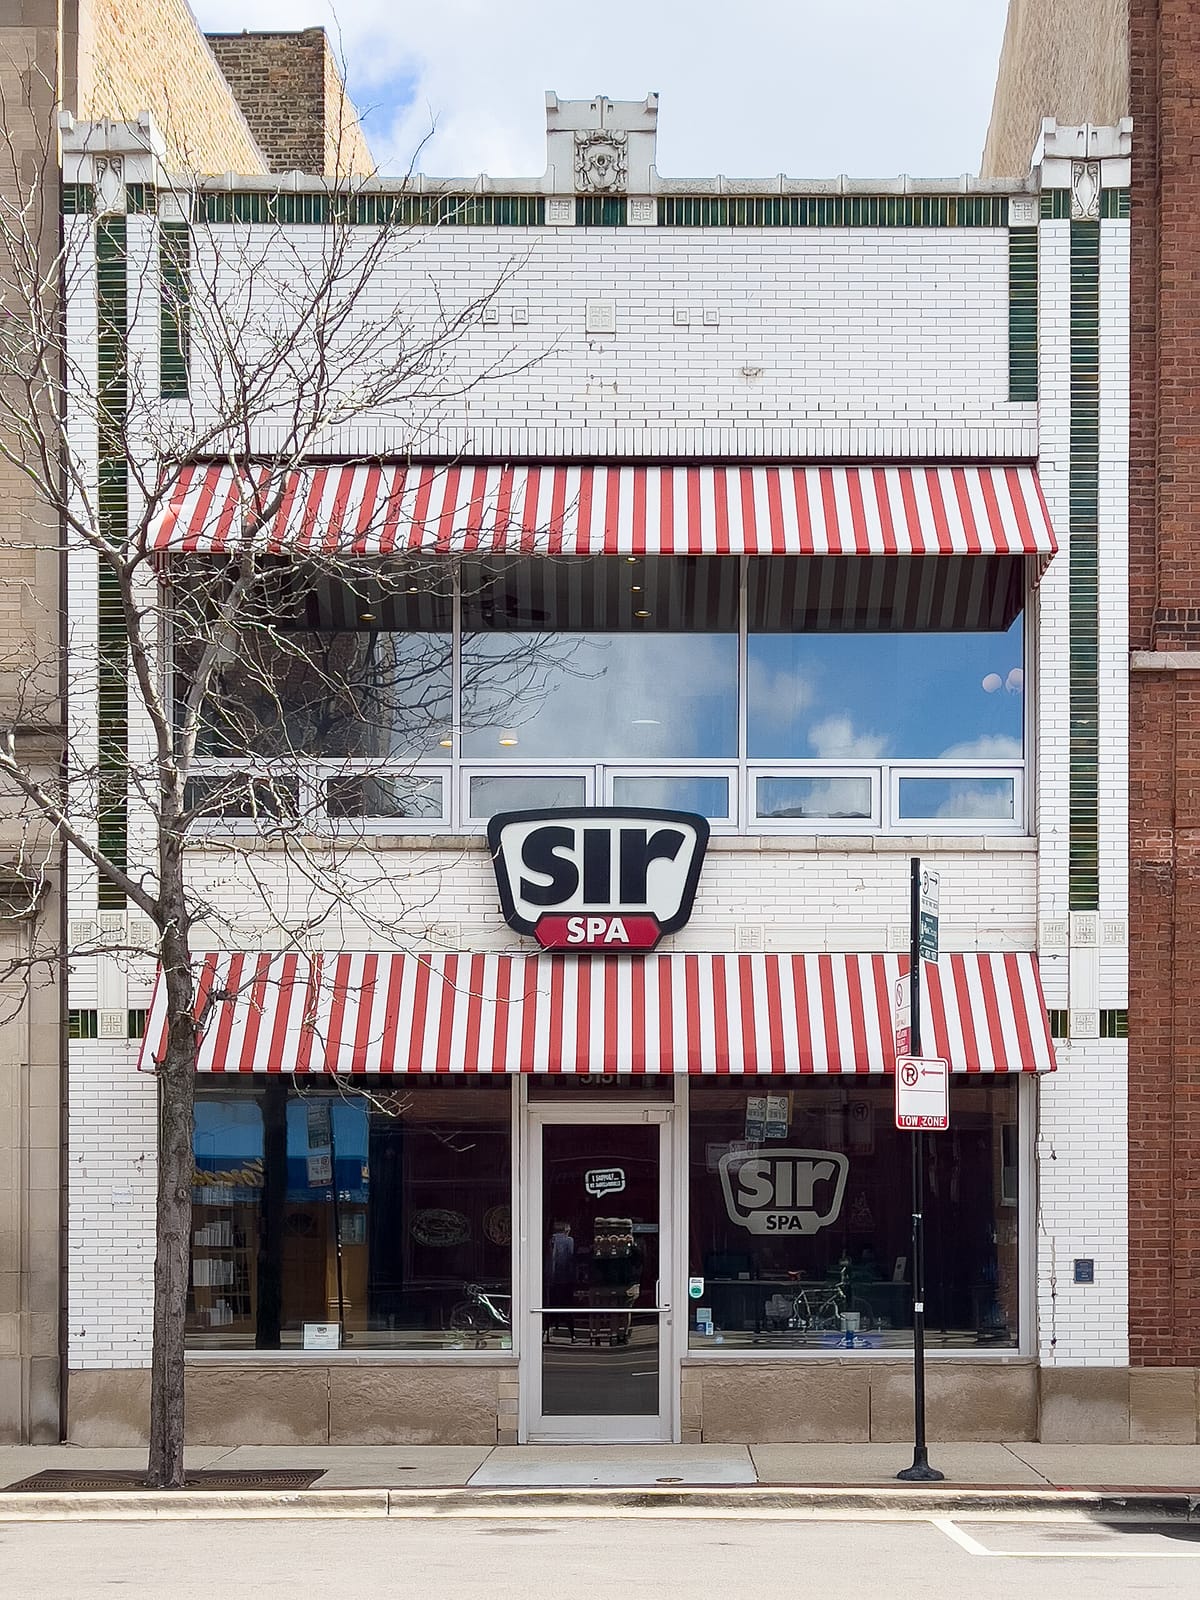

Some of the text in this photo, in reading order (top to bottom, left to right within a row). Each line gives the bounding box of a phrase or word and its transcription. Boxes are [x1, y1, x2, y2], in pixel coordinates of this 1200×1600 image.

[566, 917, 629, 943] SPA
[901, 1116, 945, 1127] TOW ZONE
[766, 1215, 802, 1230] SPA
